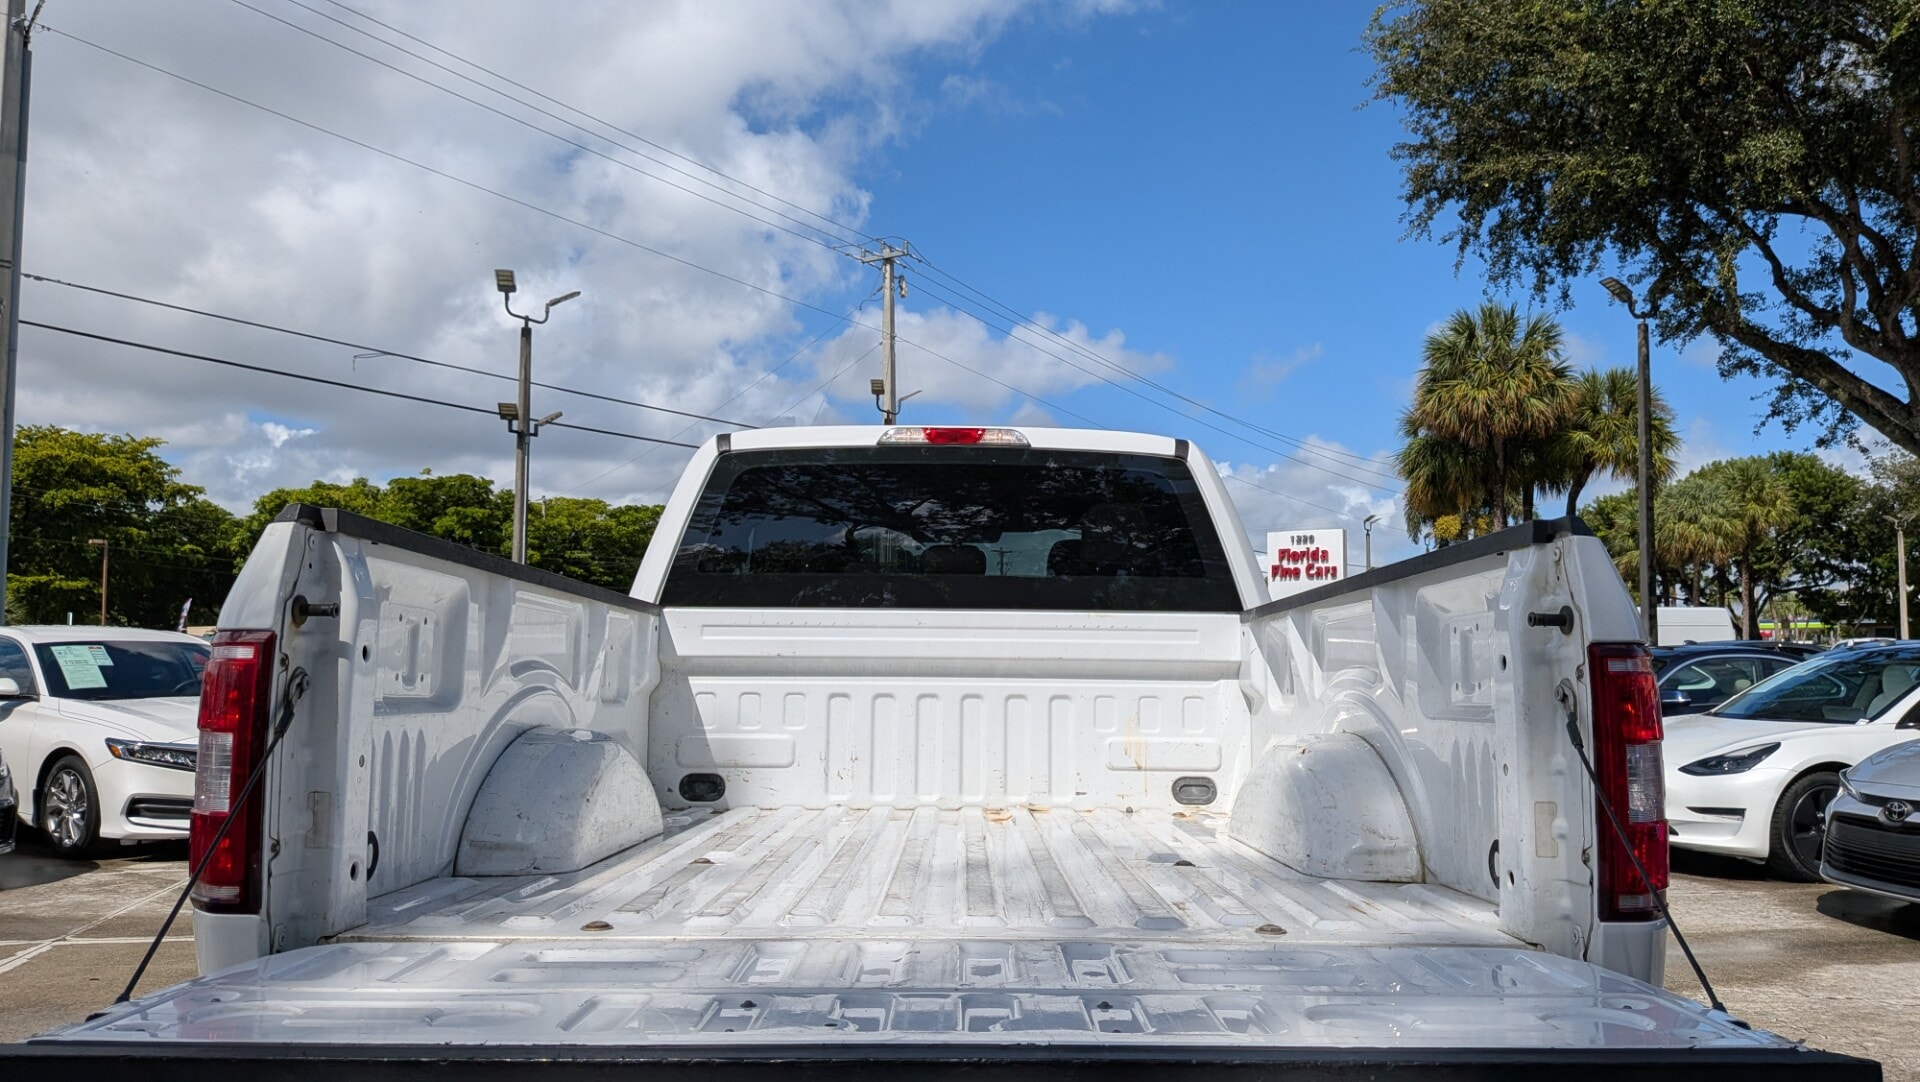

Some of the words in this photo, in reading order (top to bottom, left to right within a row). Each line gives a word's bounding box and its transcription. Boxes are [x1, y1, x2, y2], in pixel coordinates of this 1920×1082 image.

[1278, 547, 1329, 564] Florida
[1271, 565, 1301, 581] Fine
[1305, 563, 1338, 580] Cars
